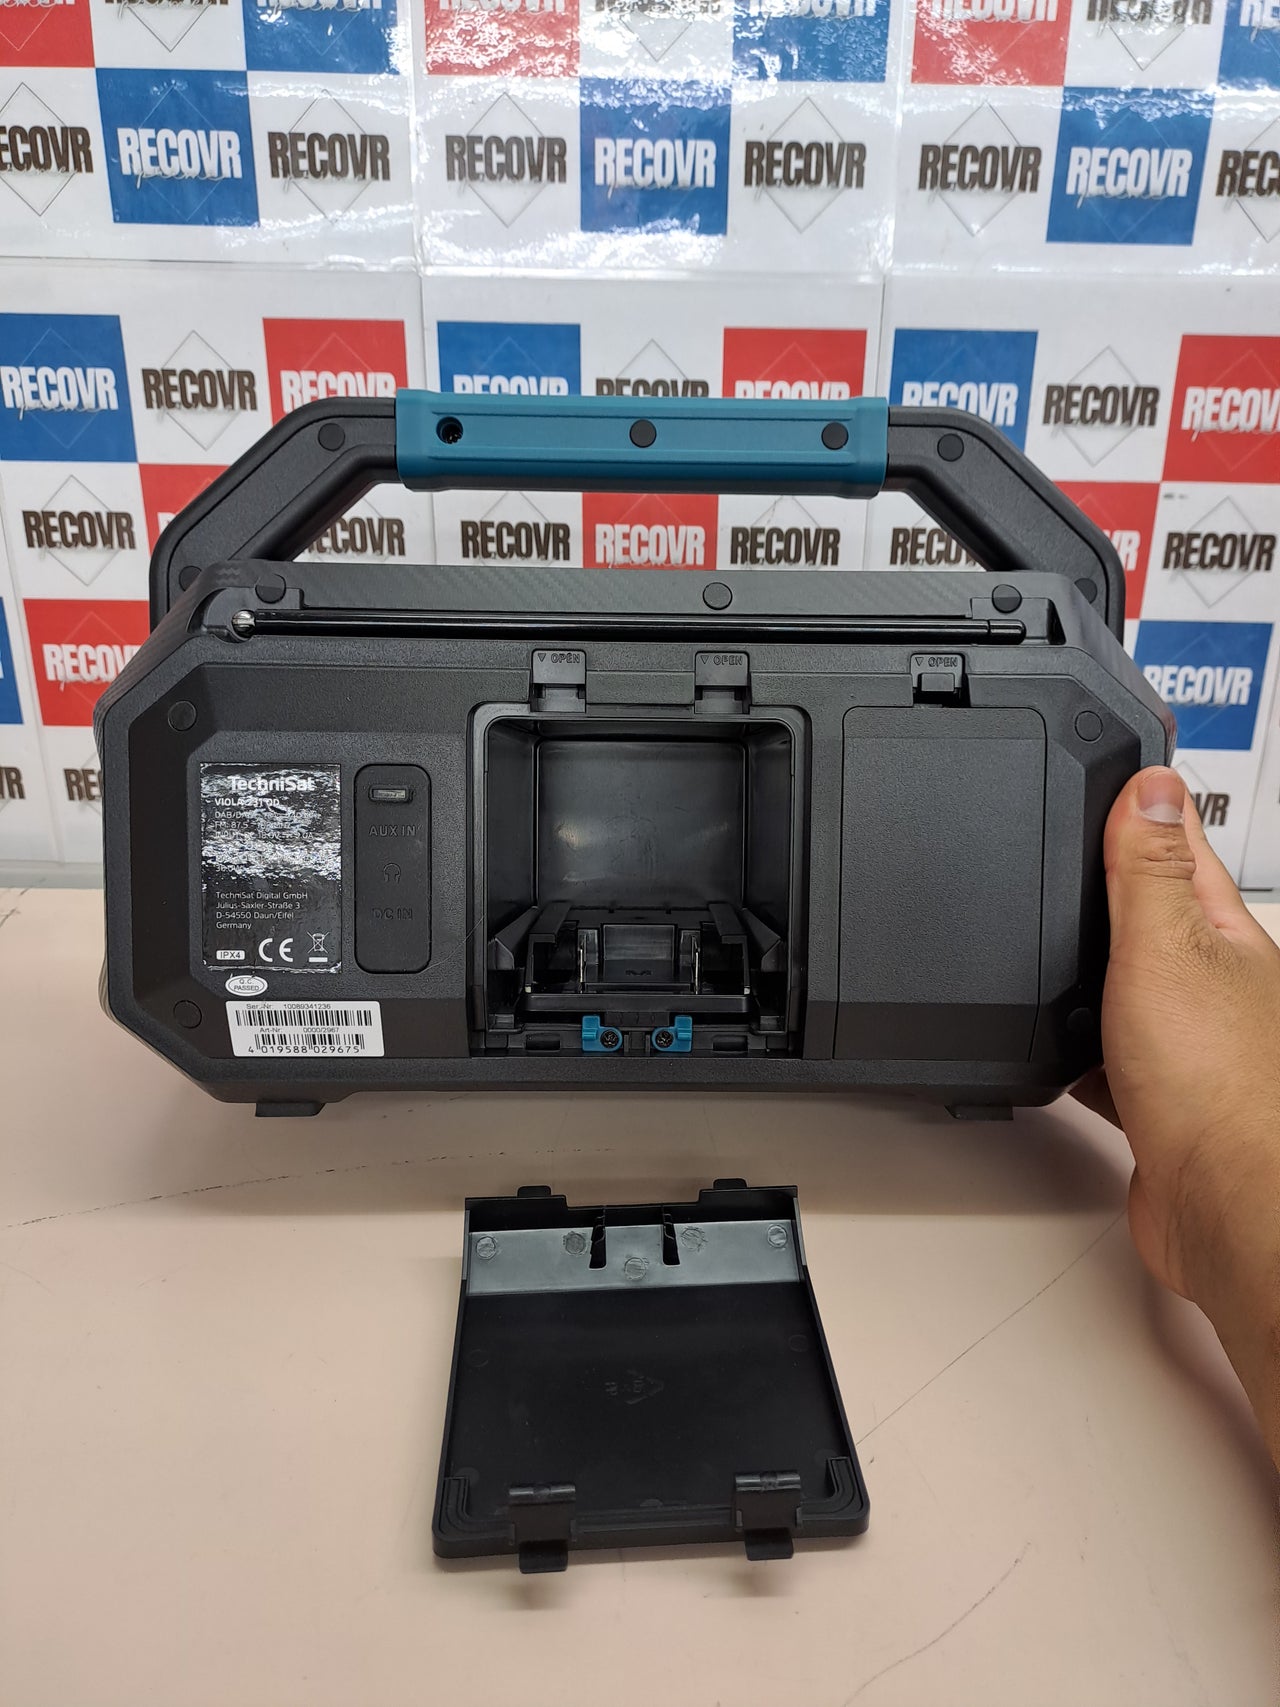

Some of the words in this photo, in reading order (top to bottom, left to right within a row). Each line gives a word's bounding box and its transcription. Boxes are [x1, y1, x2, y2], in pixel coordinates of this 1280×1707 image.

[117, 127, 243, 179] RECOVR
[268, 131, 391, 181] RECOVR
[445, 135, 567, 183] RECOVR
[594, 138, 716, 187] RECOVR
[744, 141, 867, 189] RECOVR
[918, 144, 1042, 192] RECOVR
[1065, 147, 1193, 197] RECOVR
[0, 366, 118, 410] RECOVR
[141, 368, 257, 411] RECOVR
[1042, 385, 1160, 427] RECOVR
[22, 510, 136, 549] RECOVR
[460, 520, 571, 560] RECOVR
[595, 523, 706, 565] RECOVR
[730, 526, 841, 567] RECOVR
[1162, 532, 1277, 571] RECOVR
[42, 644, 142, 681] RECOV
[551, 653, 580, 663] OPEN
[713, 655, 743, 665] OPEN
[928, 657, 958, 667] OPEN
[228, 775, 316, 792] TechniSat
[369, 825, 398, 836] AUX
[402, 825, 417, 836] IN
[254, 911, 294, 919] Daun/Eifel
[256, 891, 281, 901] Digital
[283, 891, 308, 899] GmbH
[372, 908, 394, 919] DC
[220, 951, 241, 959] IPX4
